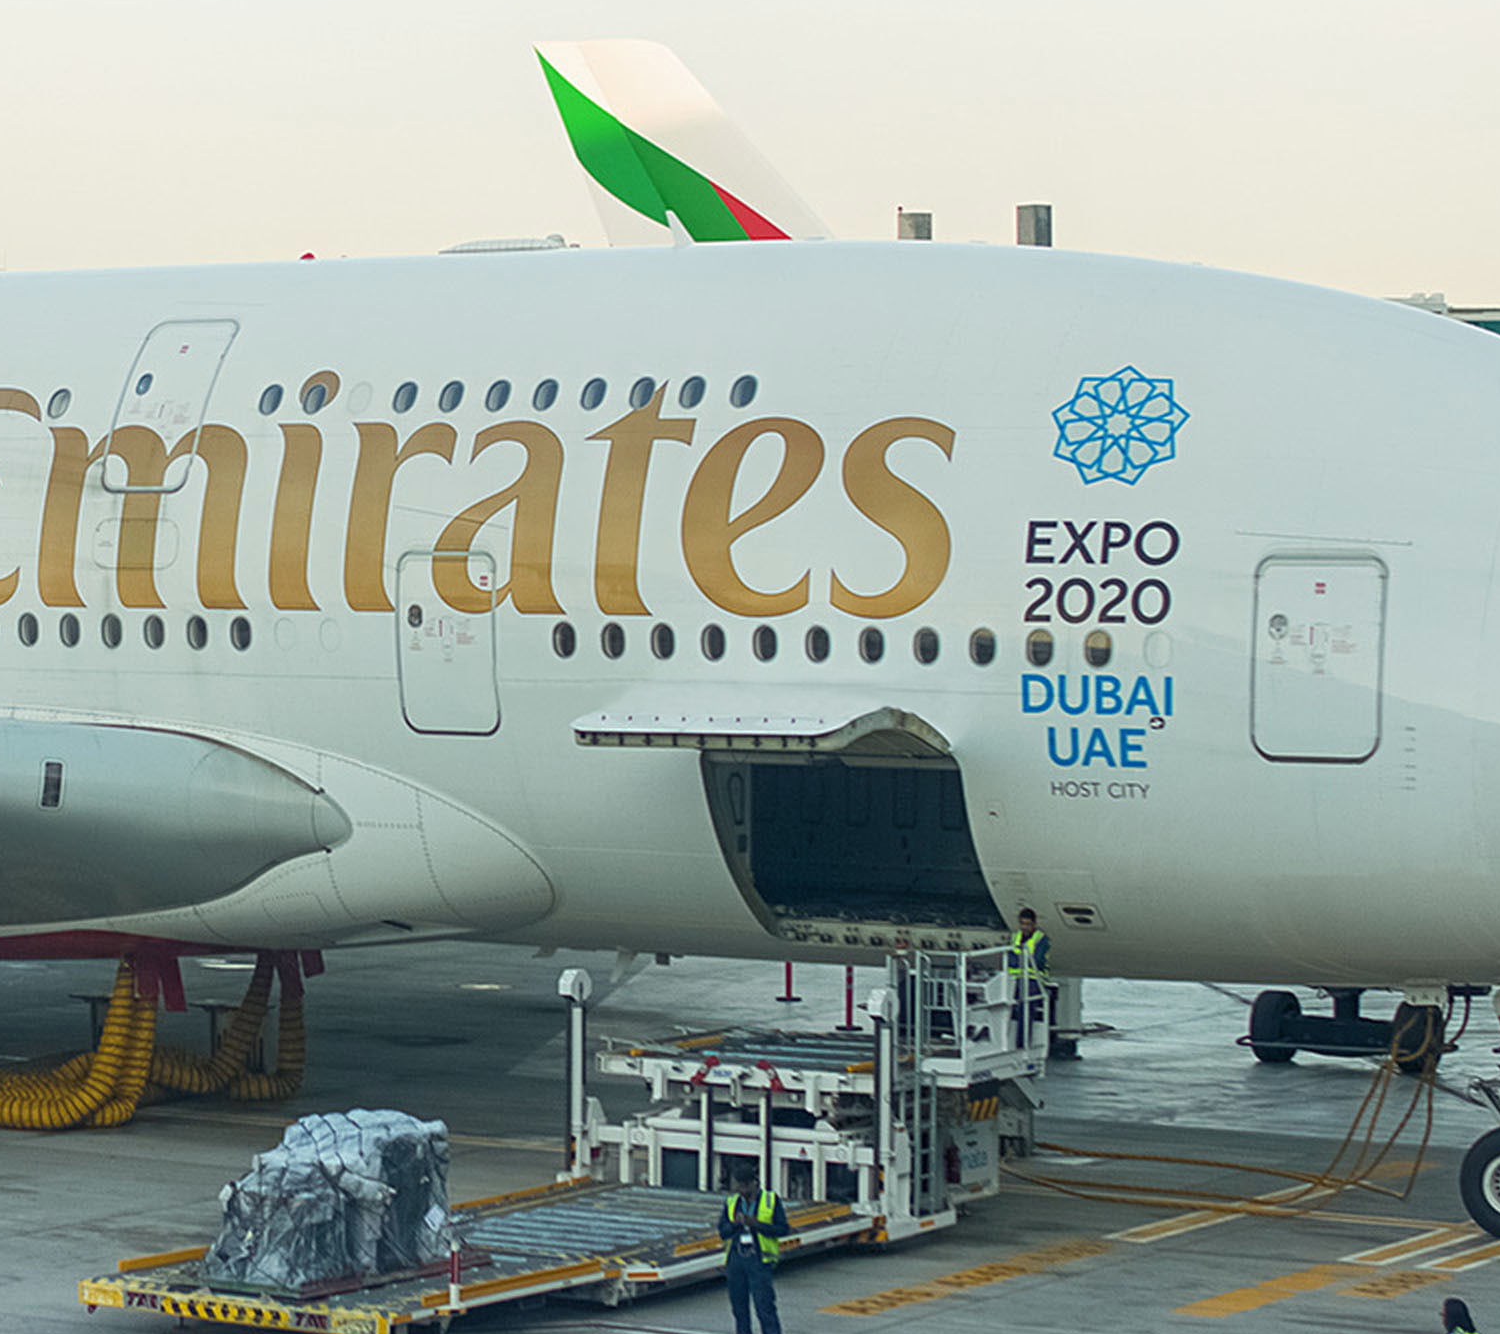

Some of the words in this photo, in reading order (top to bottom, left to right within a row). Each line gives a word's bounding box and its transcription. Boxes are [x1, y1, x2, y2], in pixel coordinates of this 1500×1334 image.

[1024, 520, 1181, 566] EXPO
[1024, 576, 1172, 625] 2020
[1020, 672, 1174, 718] DUBAI
[1046, 724, 1149, 769] UAE
[1050, 781, 1102, 799] HOST
[1107, 781, 1151, 800] CITY
